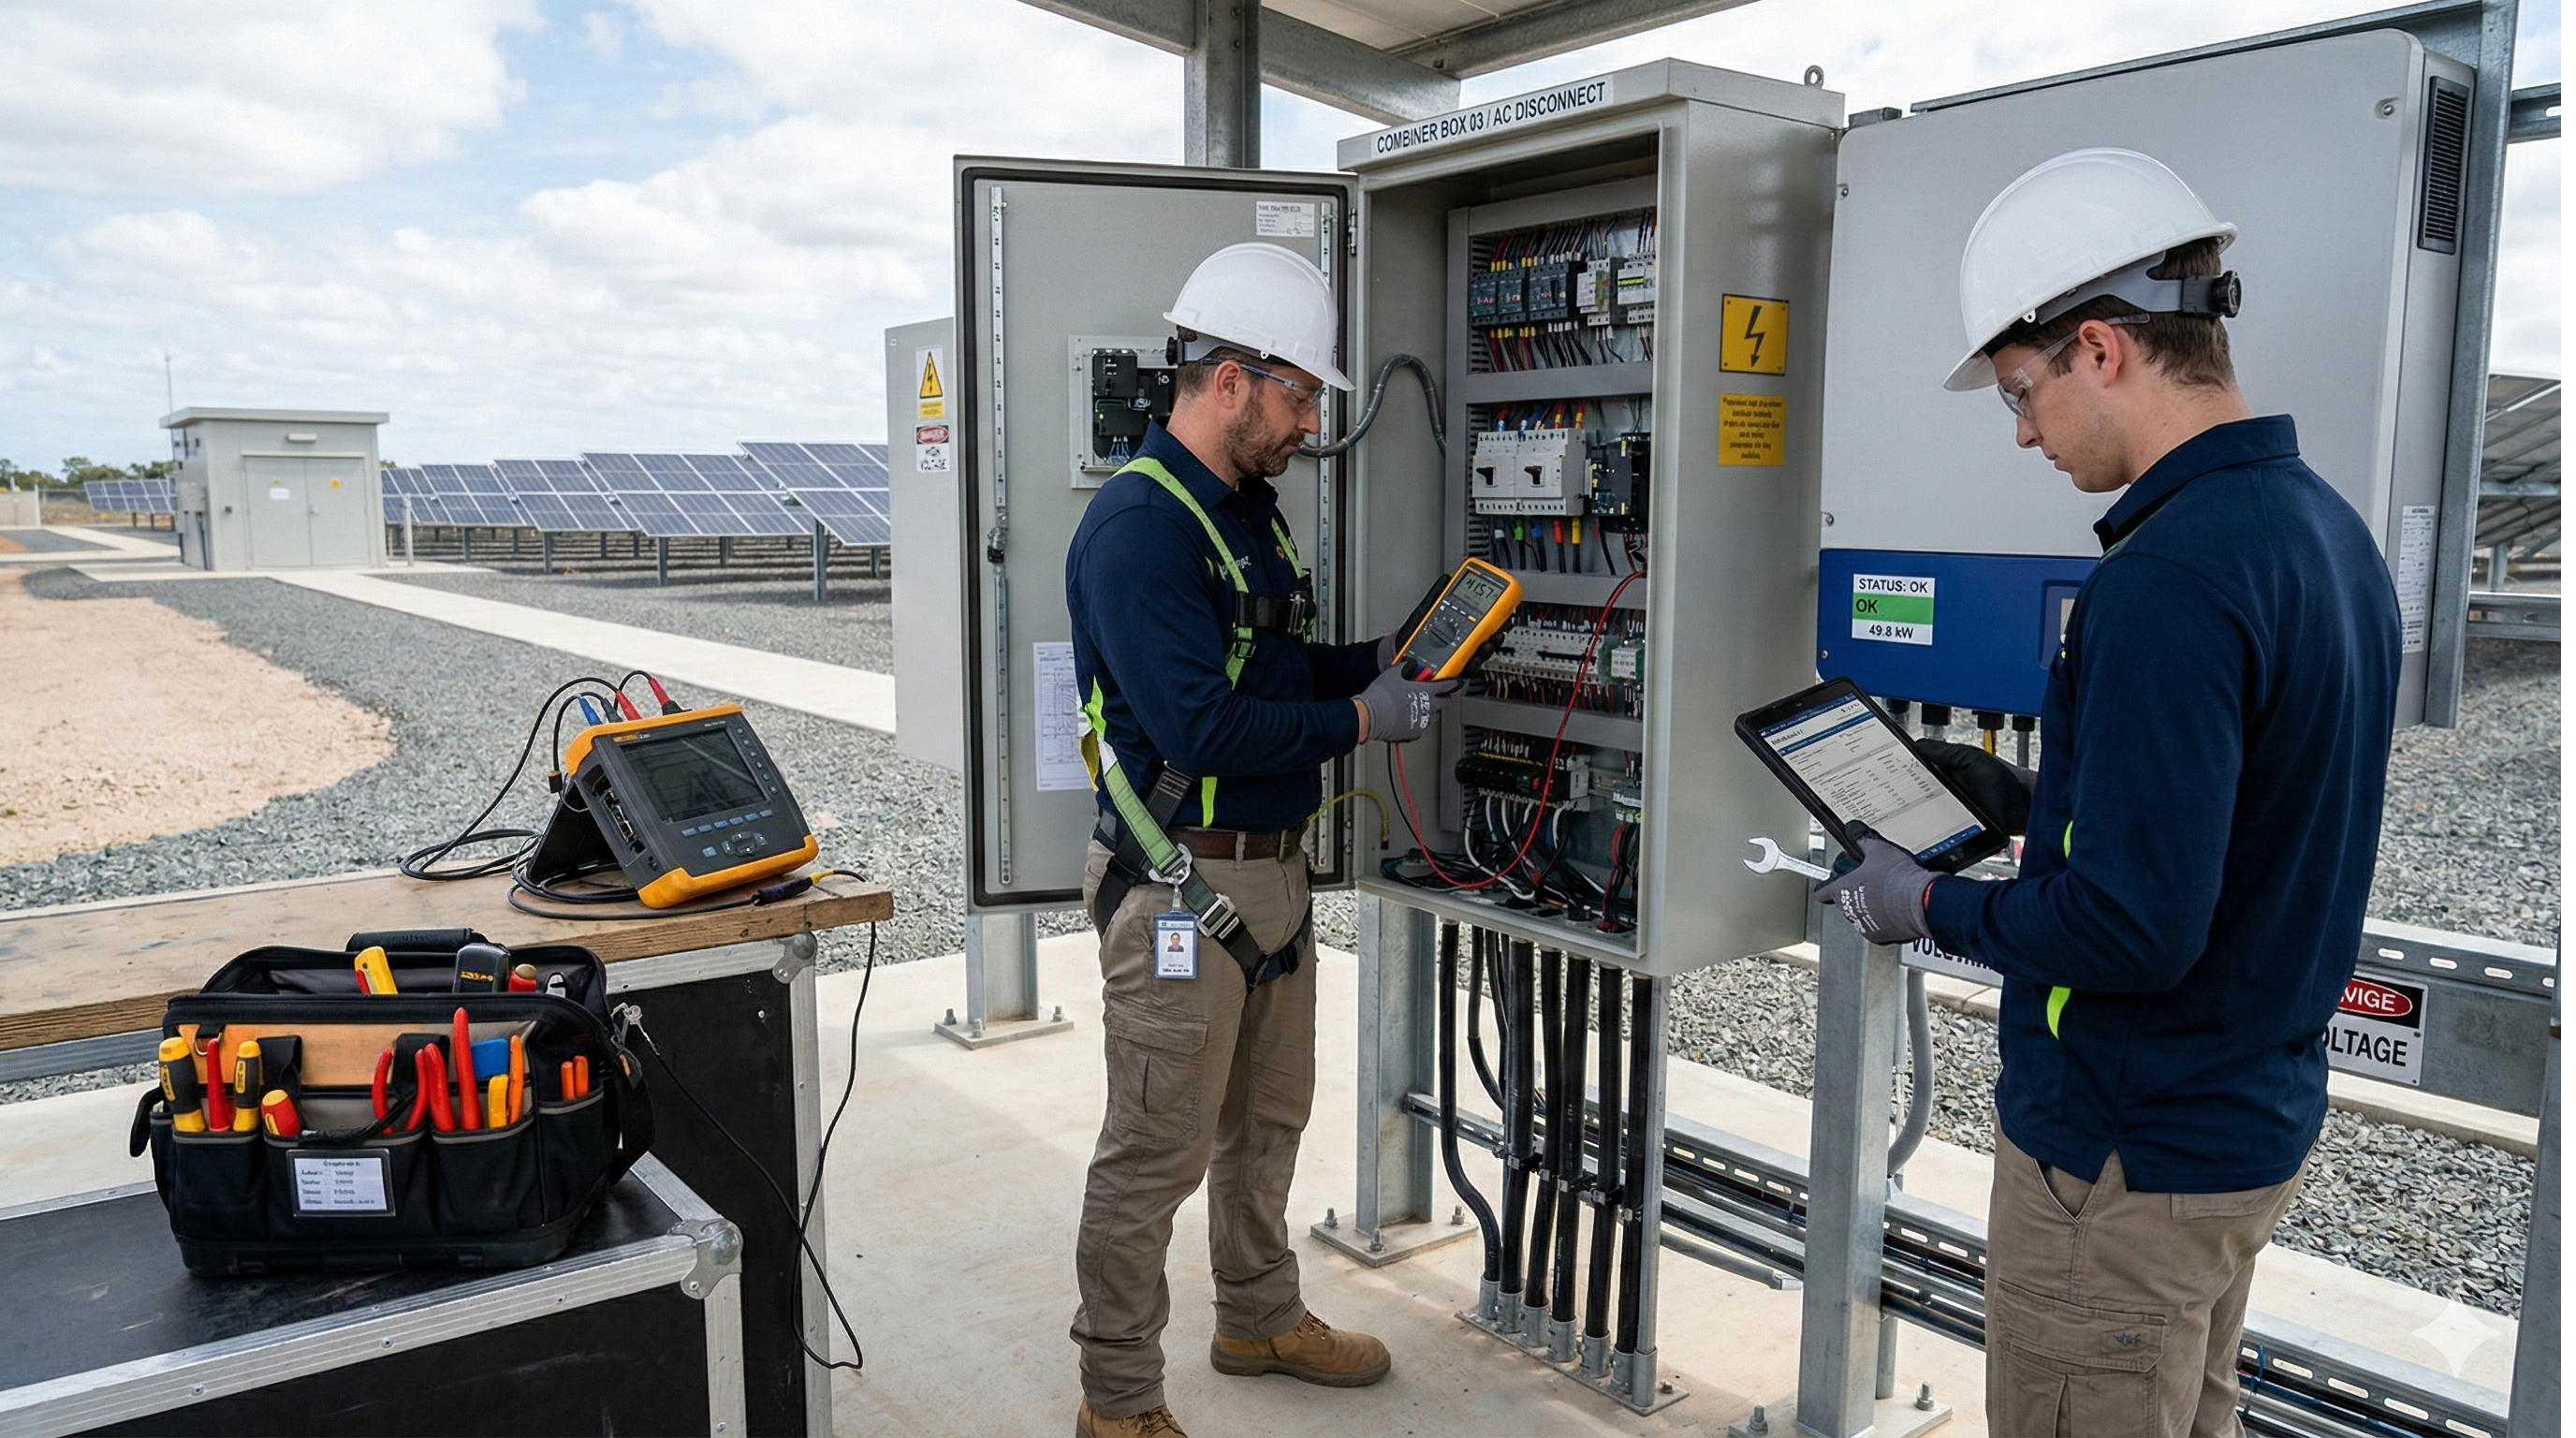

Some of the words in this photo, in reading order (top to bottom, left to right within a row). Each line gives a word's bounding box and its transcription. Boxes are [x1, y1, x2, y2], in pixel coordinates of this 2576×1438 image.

[1377, 123, 1439, 154] COMBINER
[1441, 115, 1468, 139] BOX
[1470, 112, 1485, 132] 03
[1486, 109, 1492, 128] /
[1493, 105, 1512, 126] AC
[1515, 81, 1606, 121] DISCONNECT
[1858, 578, 1907, 593] STATUS:
[1910, 580, 1928, 594] OK
[1855, 598, 1879, 614] OK
[1868, 624, 1893, 638] 49.8
[1895, 626, 1914, 639] kW
[2340, 986, 2396, 1012] VIGE
